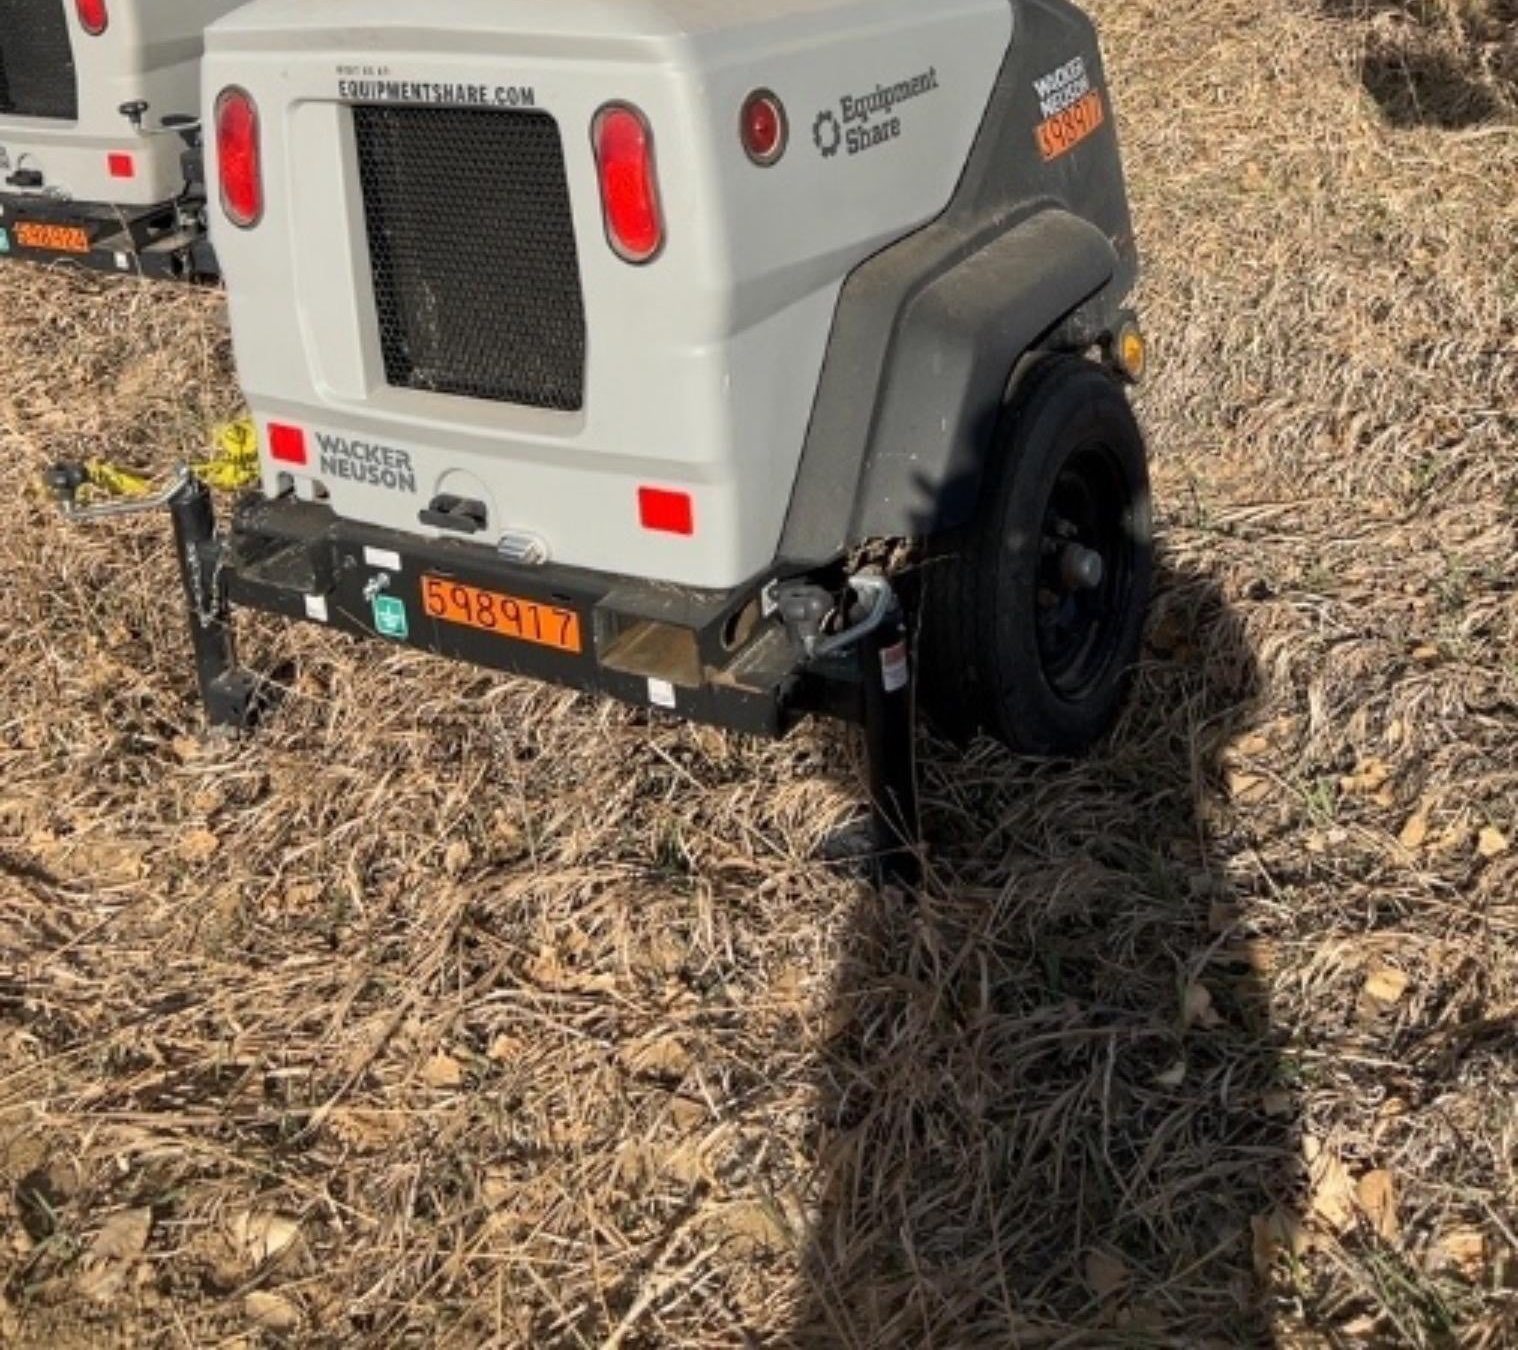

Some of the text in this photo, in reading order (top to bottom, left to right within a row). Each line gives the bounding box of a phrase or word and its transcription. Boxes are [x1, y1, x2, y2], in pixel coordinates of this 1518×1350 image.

[337, 80, 535, 106] EQUIPMENTSHARE.COM
[839, 65, 939, 123] Equipment
[1032, 55, 1086, 99] WACKER
[845, 116, 901, 156] Share
[315, 431, 413, 472] WACKER
[320, 455, 416, 493] NEUSON
[427, 579, 571, 646] 598917
